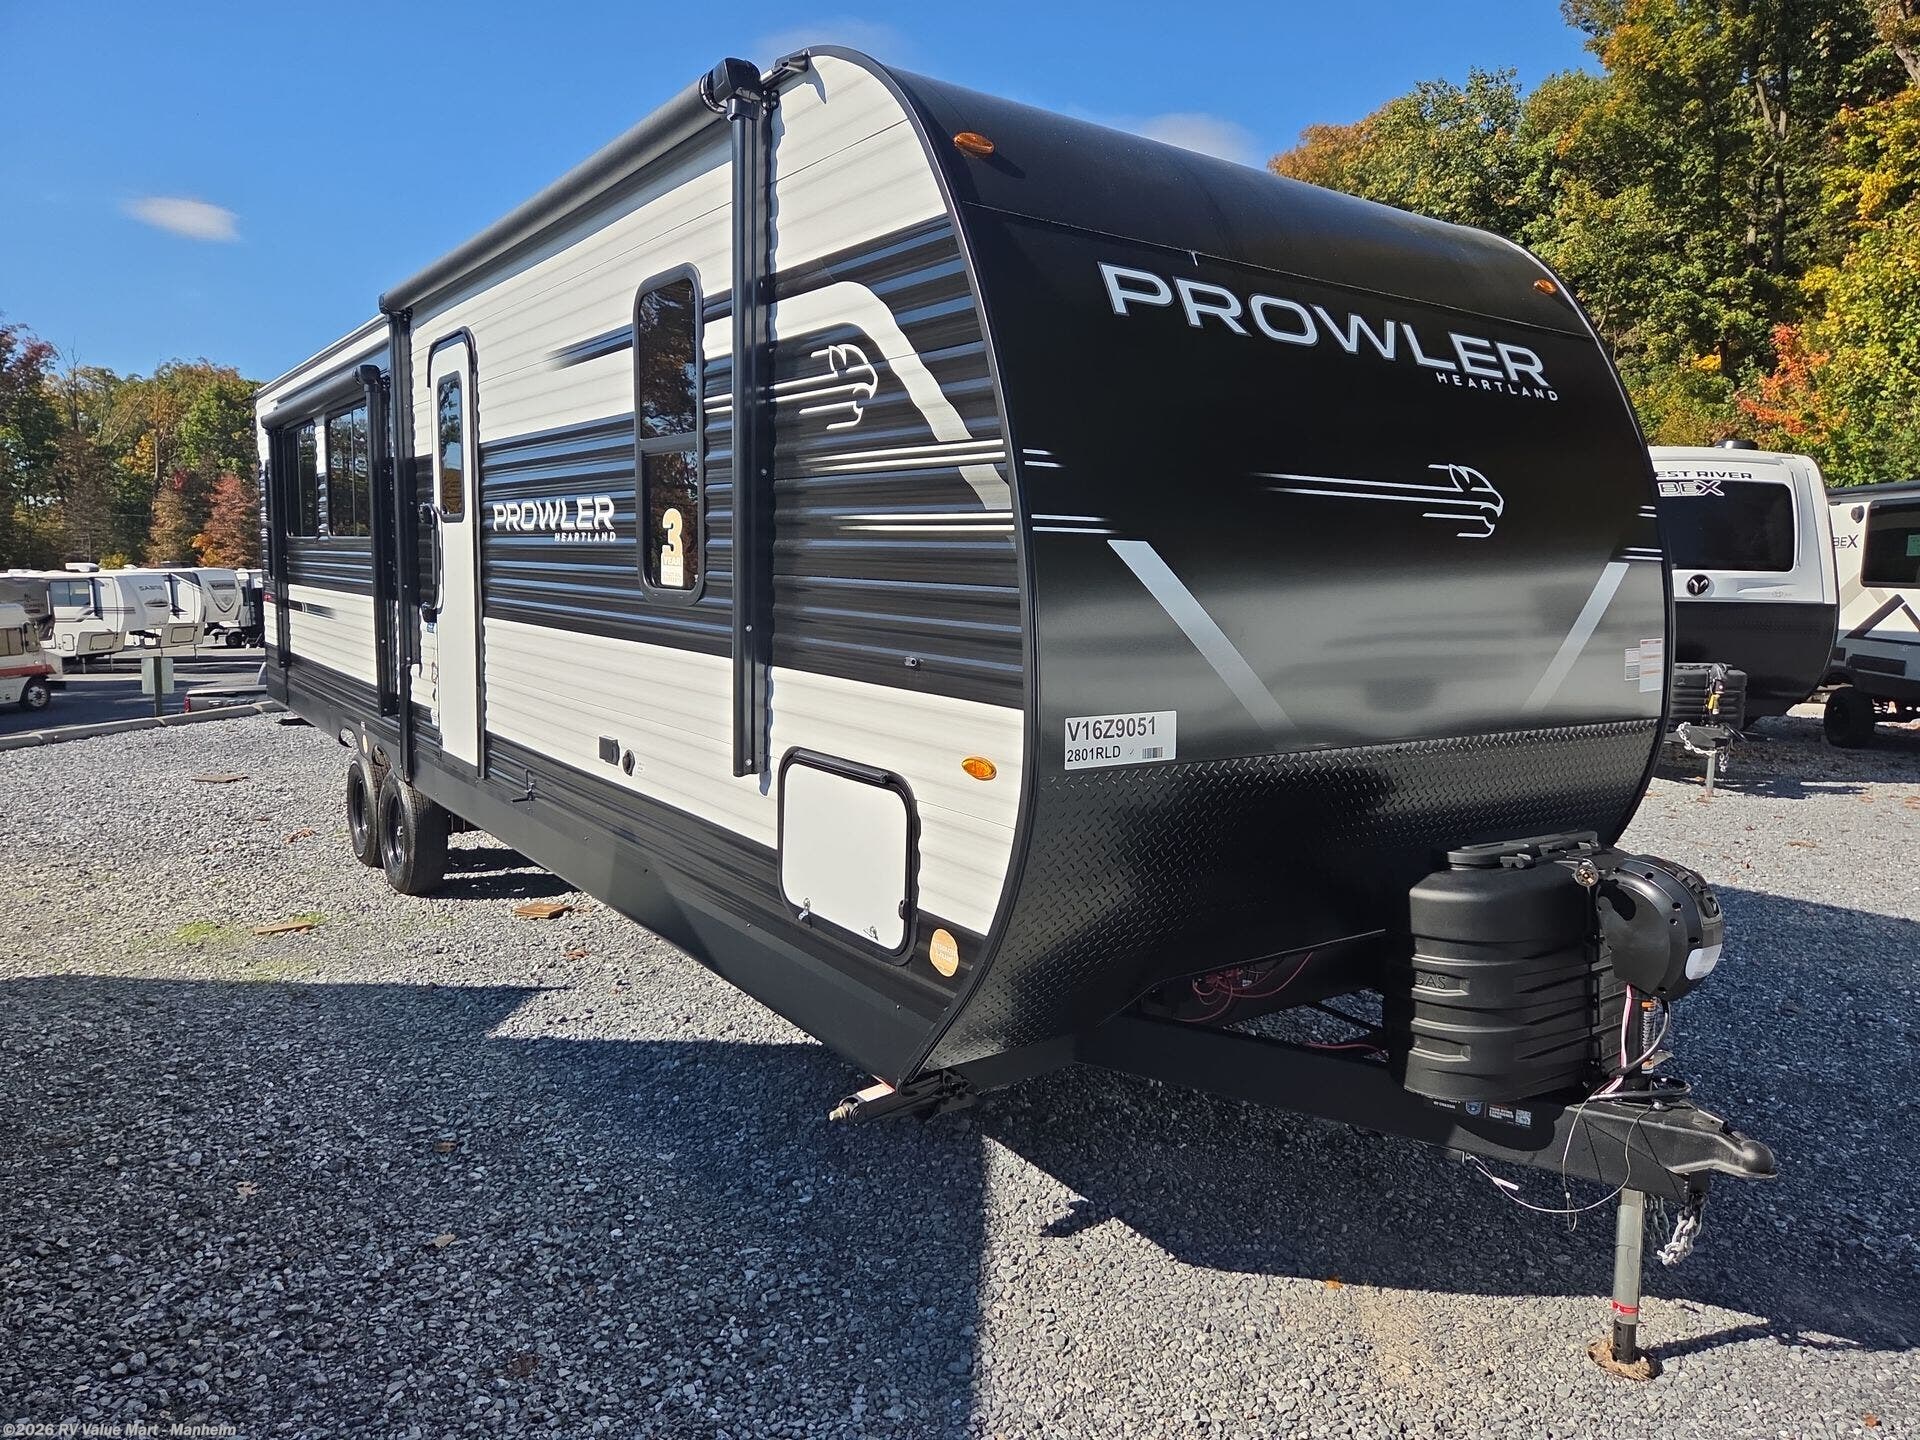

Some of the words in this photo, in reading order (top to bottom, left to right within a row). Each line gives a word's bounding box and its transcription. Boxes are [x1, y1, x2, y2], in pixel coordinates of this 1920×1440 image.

[1098, 262, 1552, 387] PROWLER
[1435, 372, 1559, 401] HEARTLAND
[1695, 471, 1753, 480] RIVER
[492, 495, 615, 532] PROWLER
[554, 532, 616, 542] HEARTLAND
[662, 508, 683, 555] 3
[1066, 716, 1157, 742] V16Z9051
[1066, 745, 1121, 763] 2801RLD
